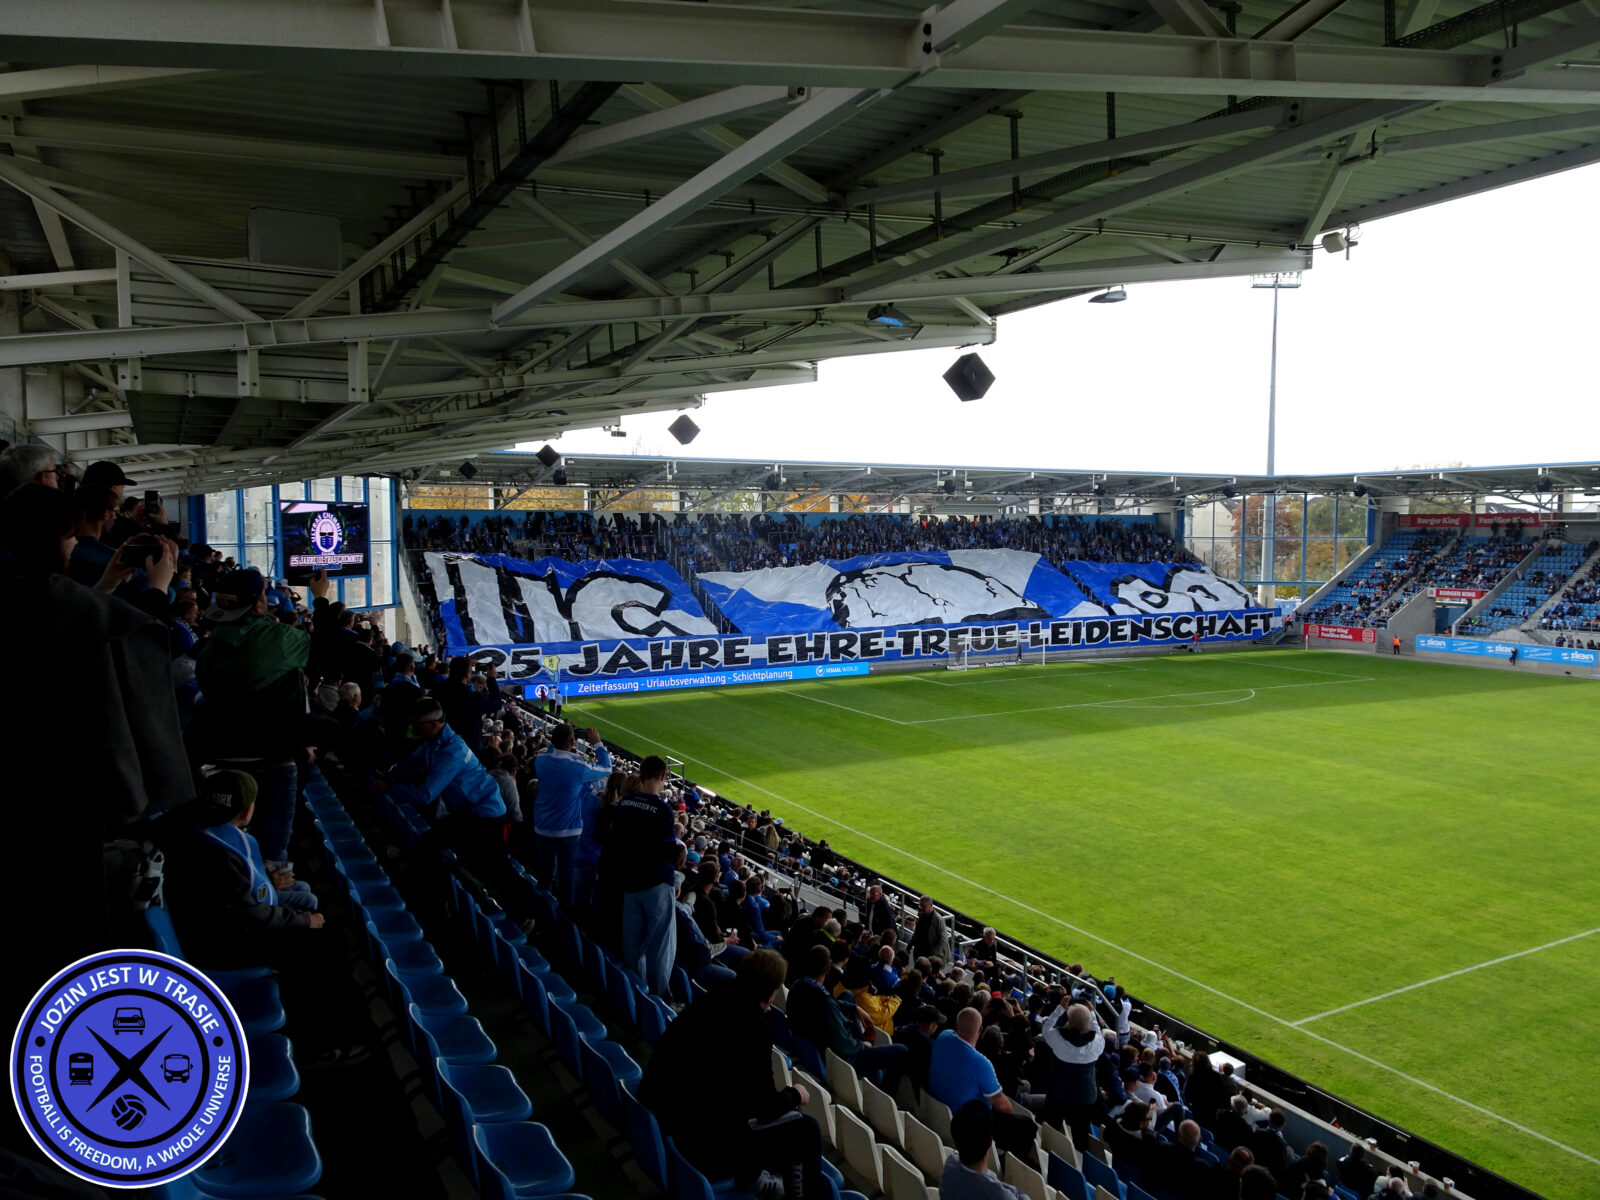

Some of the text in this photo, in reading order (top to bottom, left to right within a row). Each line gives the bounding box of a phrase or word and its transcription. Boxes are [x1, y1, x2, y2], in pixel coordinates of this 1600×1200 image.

[310, 514, 322, 543] ULTRAS
[568, 637, 752, 676] JAHRE
[842, 665, 859, 673] WORLD
[578, 681, 639, 693] Zeiterfassung
[646, 673, 726, 689] Urlaubsverwaltung
[732, 670, 793, 683] Schichtplanung
